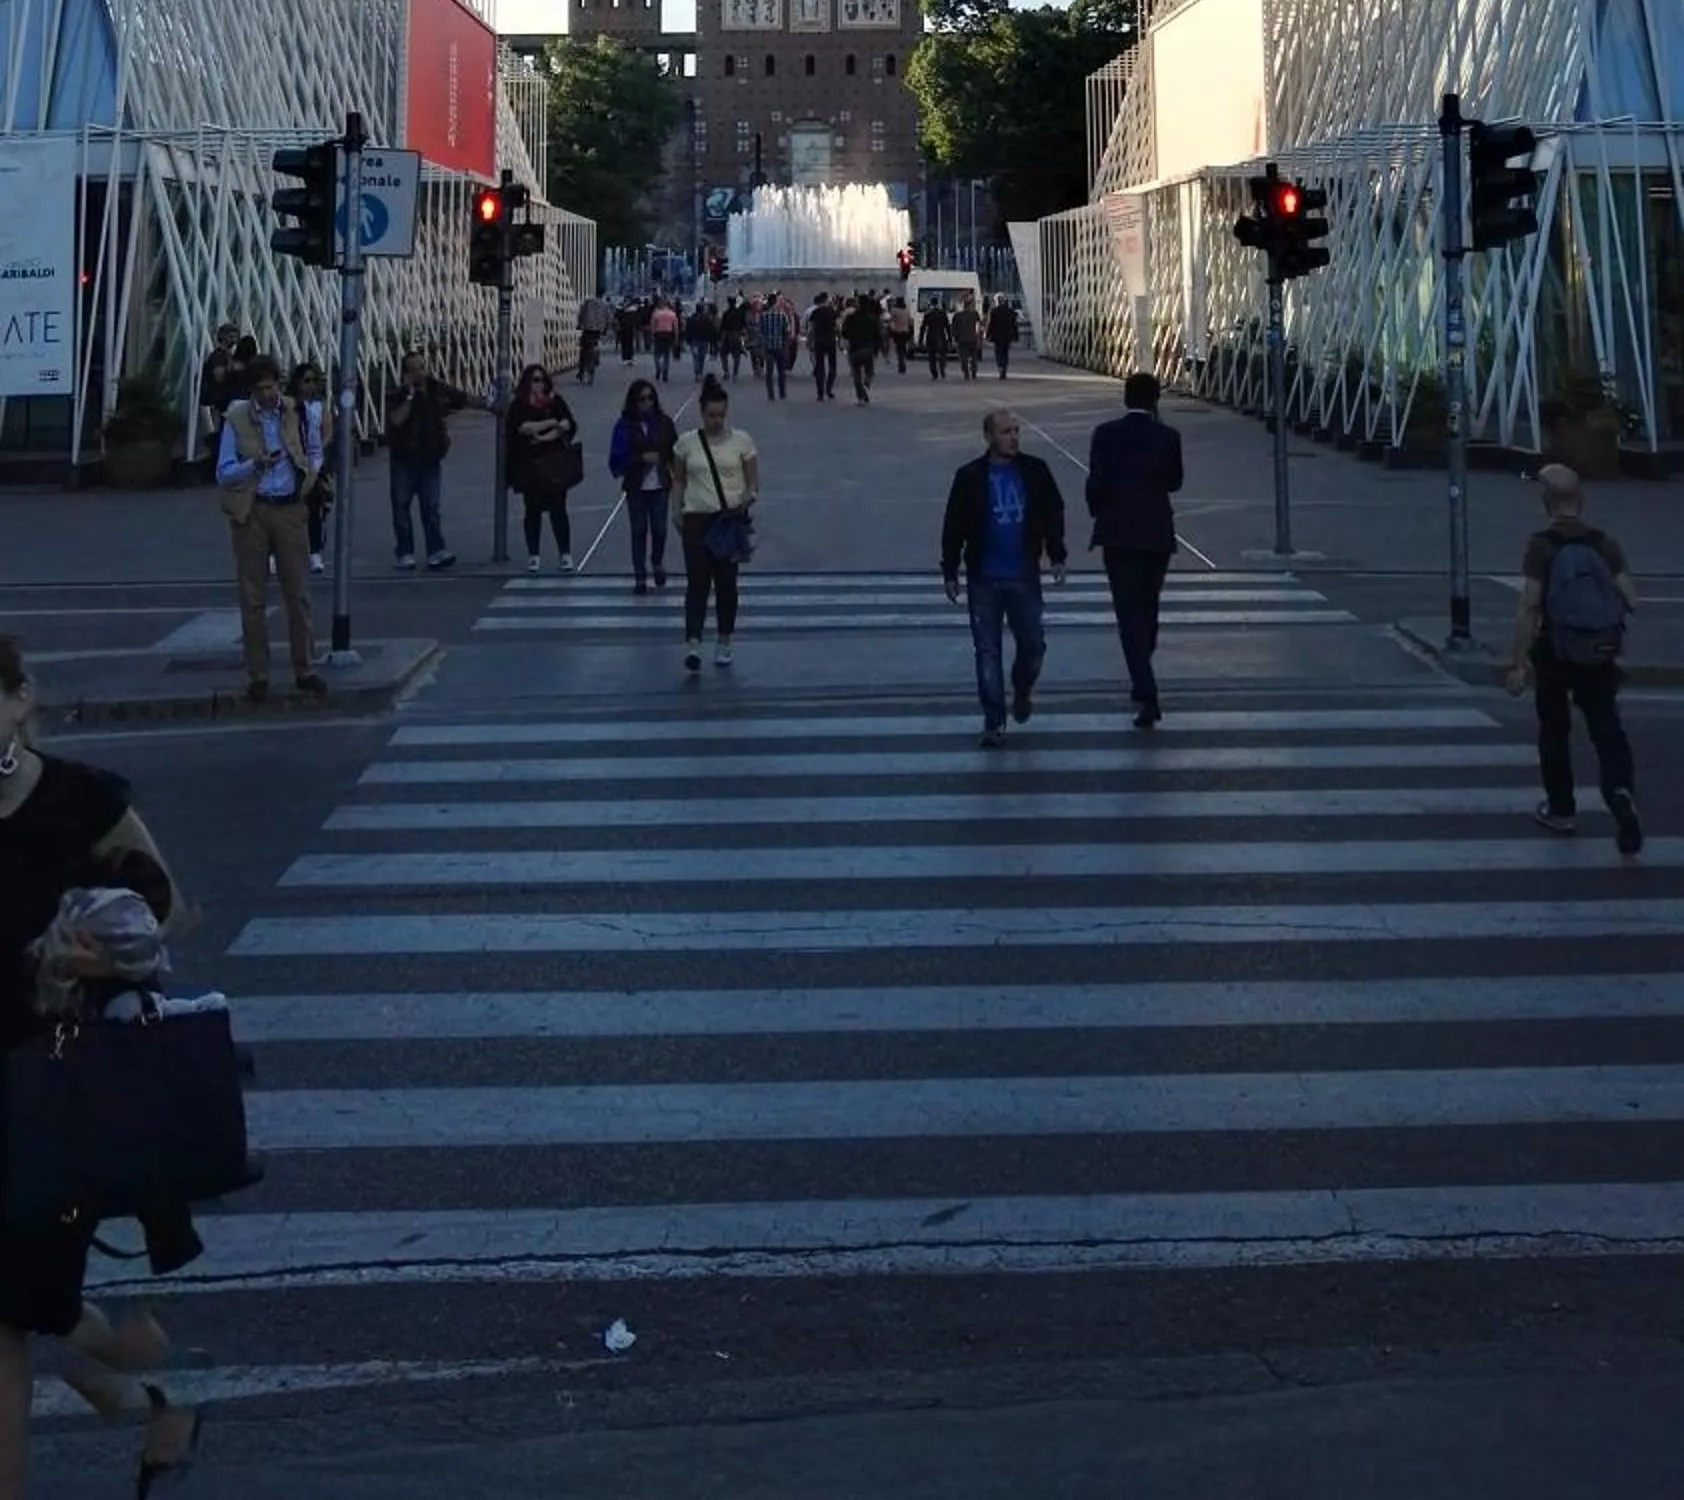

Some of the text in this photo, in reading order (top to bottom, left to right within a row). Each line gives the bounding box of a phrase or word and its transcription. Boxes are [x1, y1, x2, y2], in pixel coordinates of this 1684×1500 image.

[360, 157, 383, 168] rea
[341, 174, 401, 188] onale
[0, 267, 55, 279] ARIBALDI
[3, 311, 62, 344] ATE
[990, 472, 1025, 525] LA
